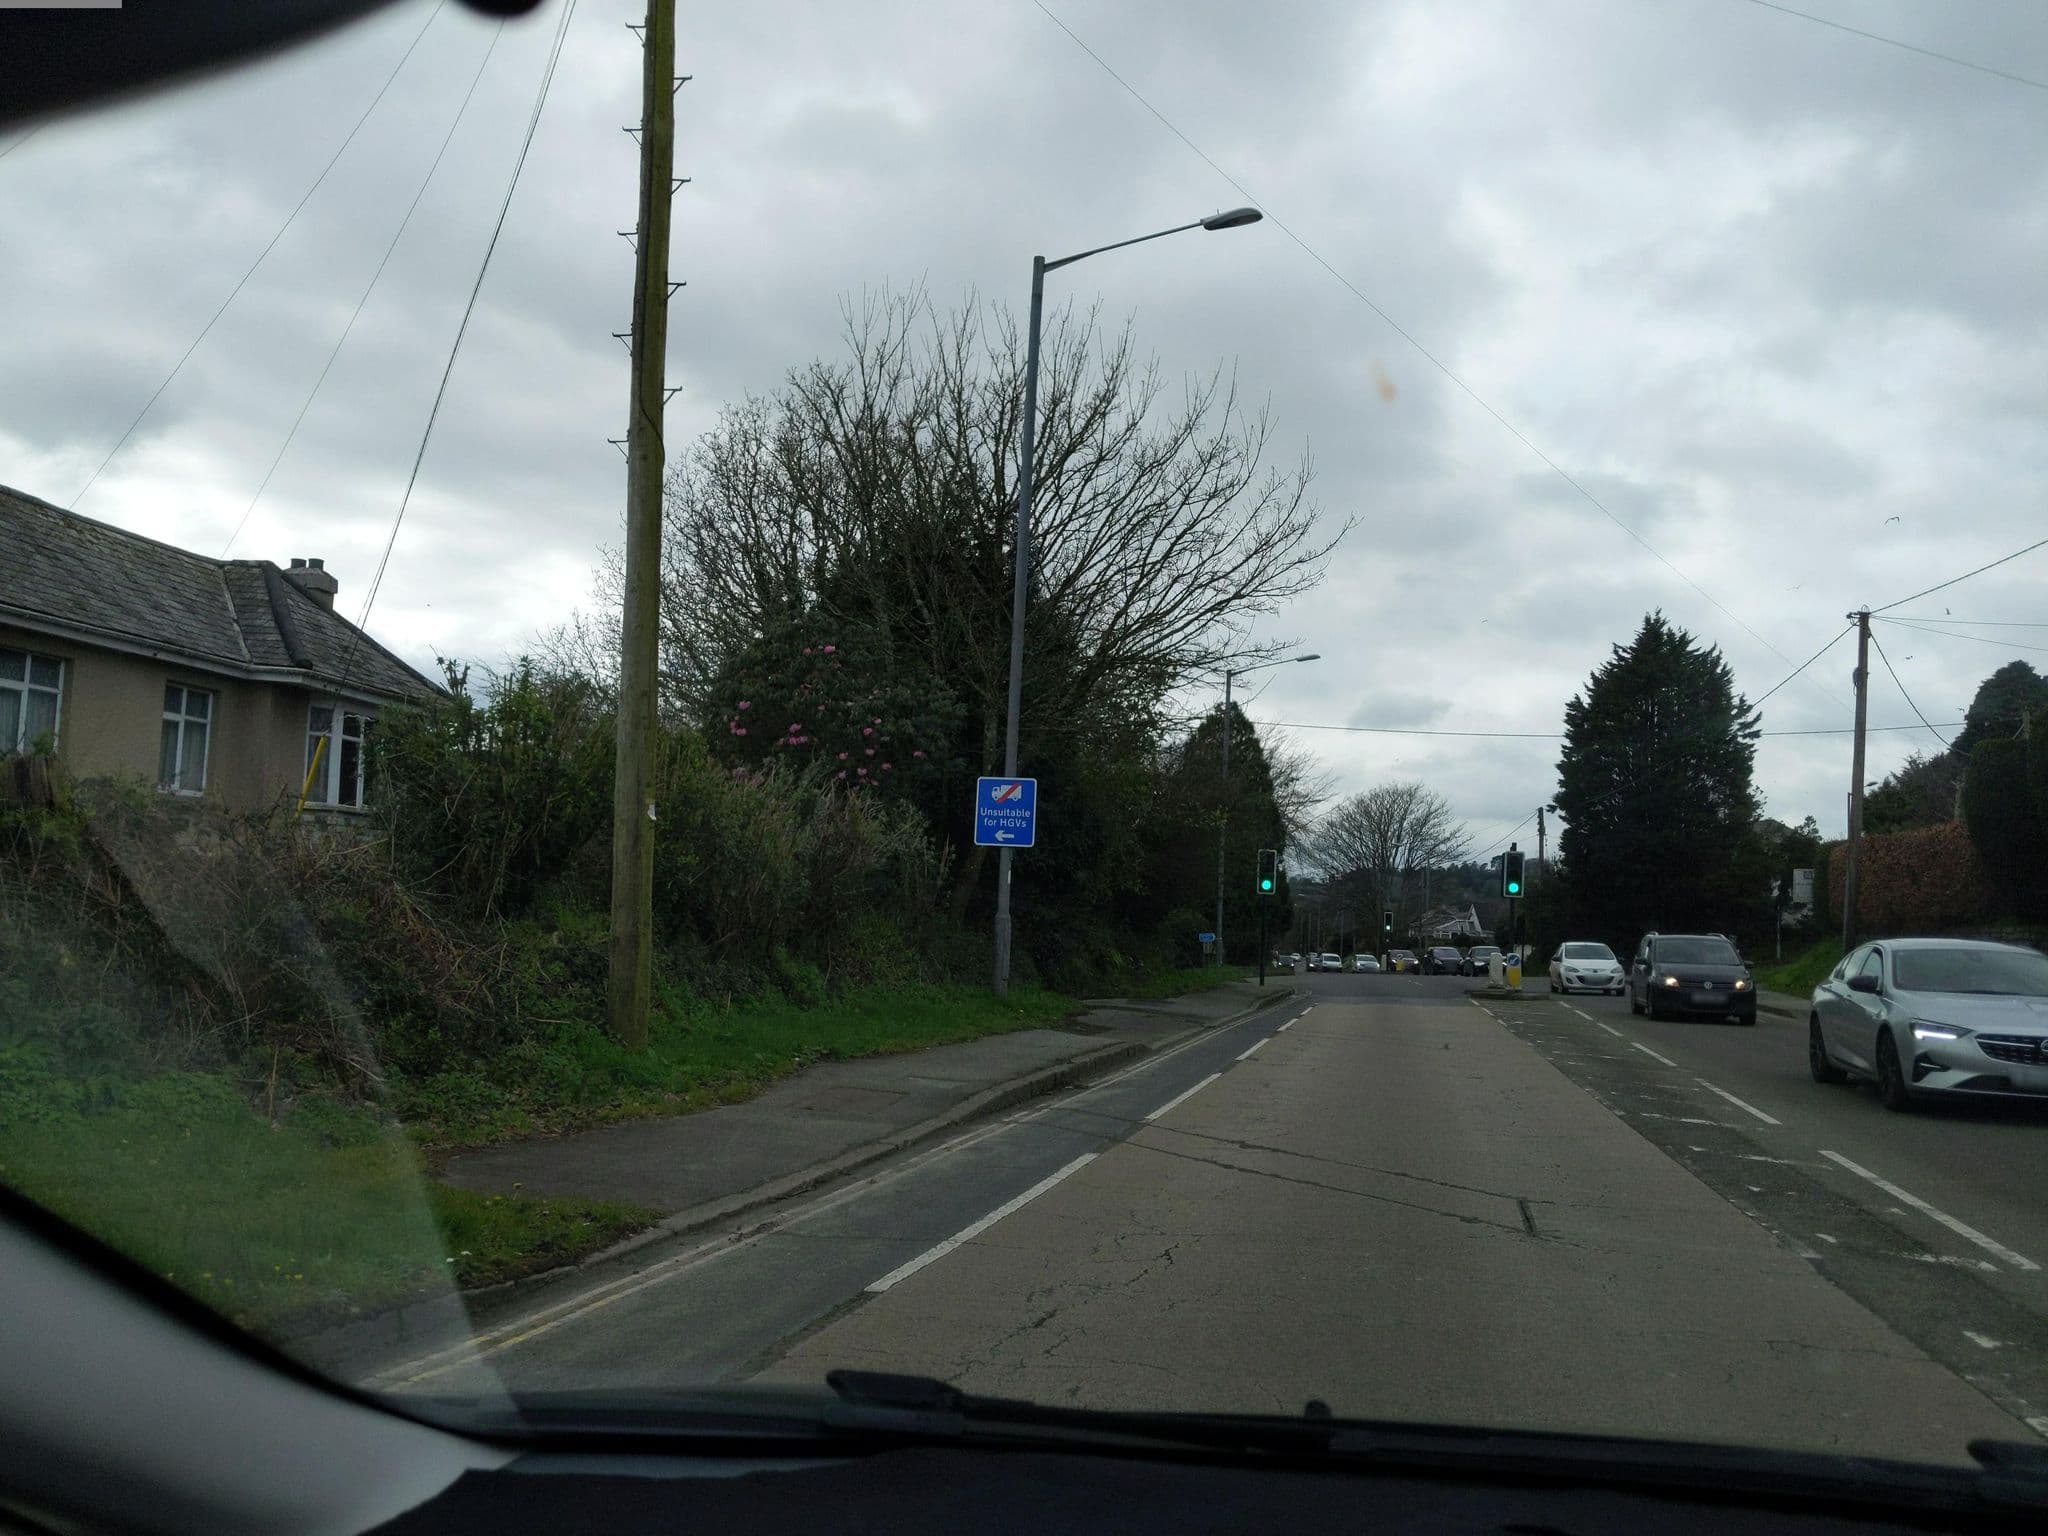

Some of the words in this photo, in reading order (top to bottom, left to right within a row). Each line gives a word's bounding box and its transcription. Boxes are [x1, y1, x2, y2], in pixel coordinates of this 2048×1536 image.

[980, 807, 1031, 818] Unsuitable
[984, 817, 997, 826] for
[1000, 818, 1027, 828] HGVs
